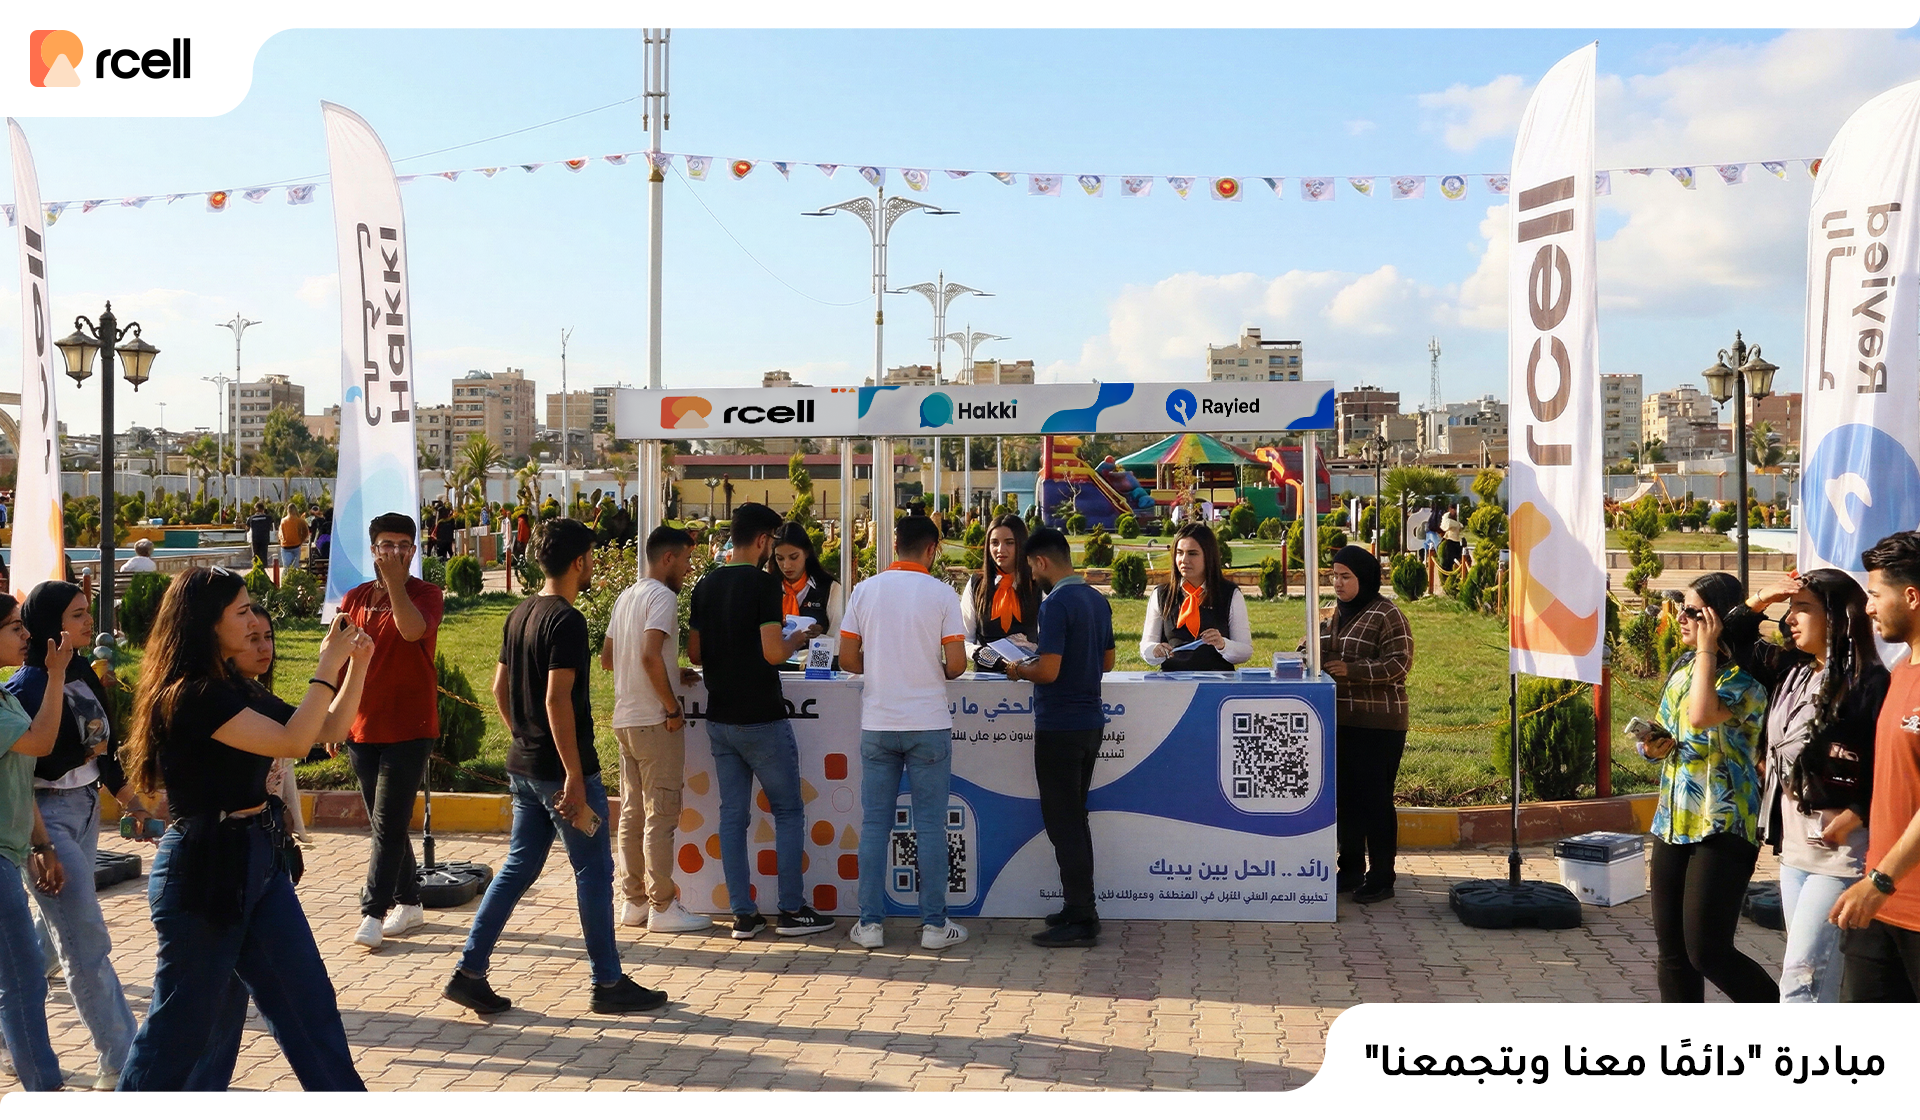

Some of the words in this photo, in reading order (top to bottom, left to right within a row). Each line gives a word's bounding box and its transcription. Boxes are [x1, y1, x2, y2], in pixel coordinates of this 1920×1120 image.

[1518, 175, 1575, 466] rcell
[724, 399, 815, 424] rcell
[959, 399, 1018, 420] Hakki
[1203, 398, 1260, 418] Rayied
[1149, 858, 1192, 881] يديك
[1234, 859, 1276, 881] الحل
[1297, 858, 1329, 882] رائد
